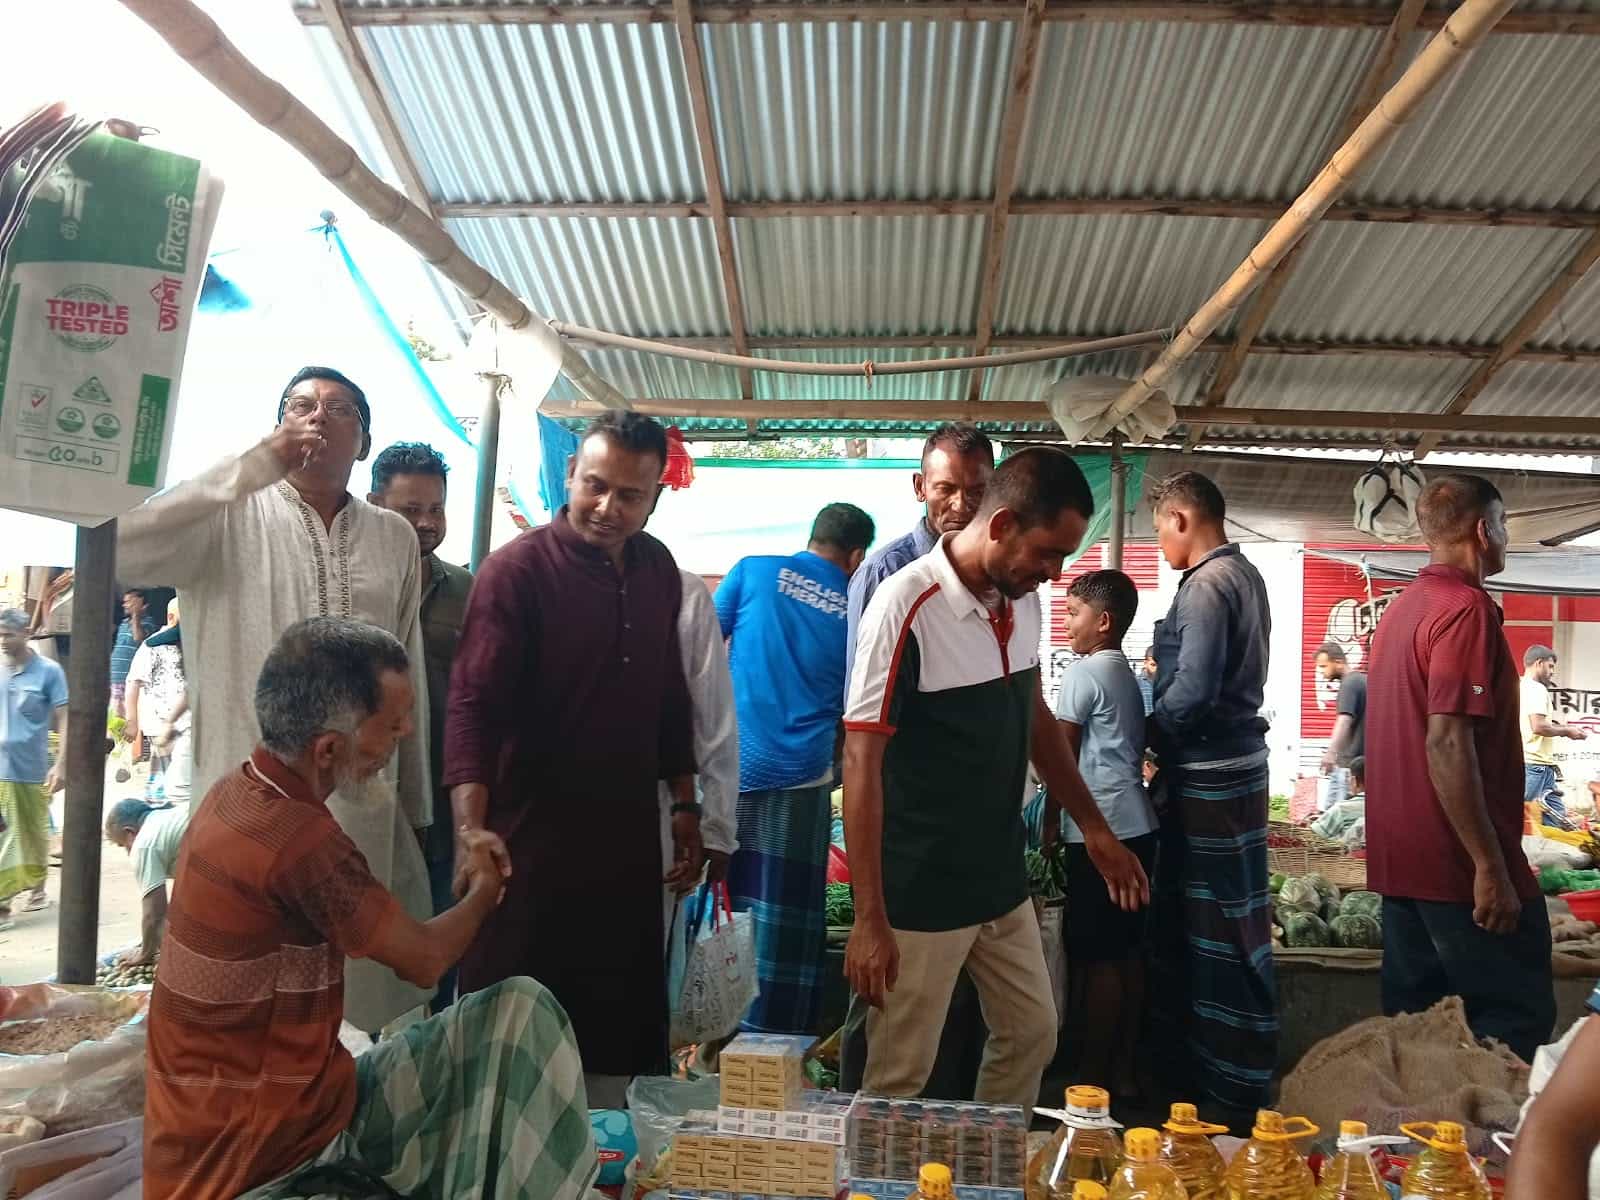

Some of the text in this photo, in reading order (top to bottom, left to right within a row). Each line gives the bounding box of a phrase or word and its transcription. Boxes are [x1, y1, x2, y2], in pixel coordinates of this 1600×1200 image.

[157, 192, 191, 268] সিমেন্ট
[46, 299, 129, 321] TRIPLE
[46, 316, 129, 336] TESTED
